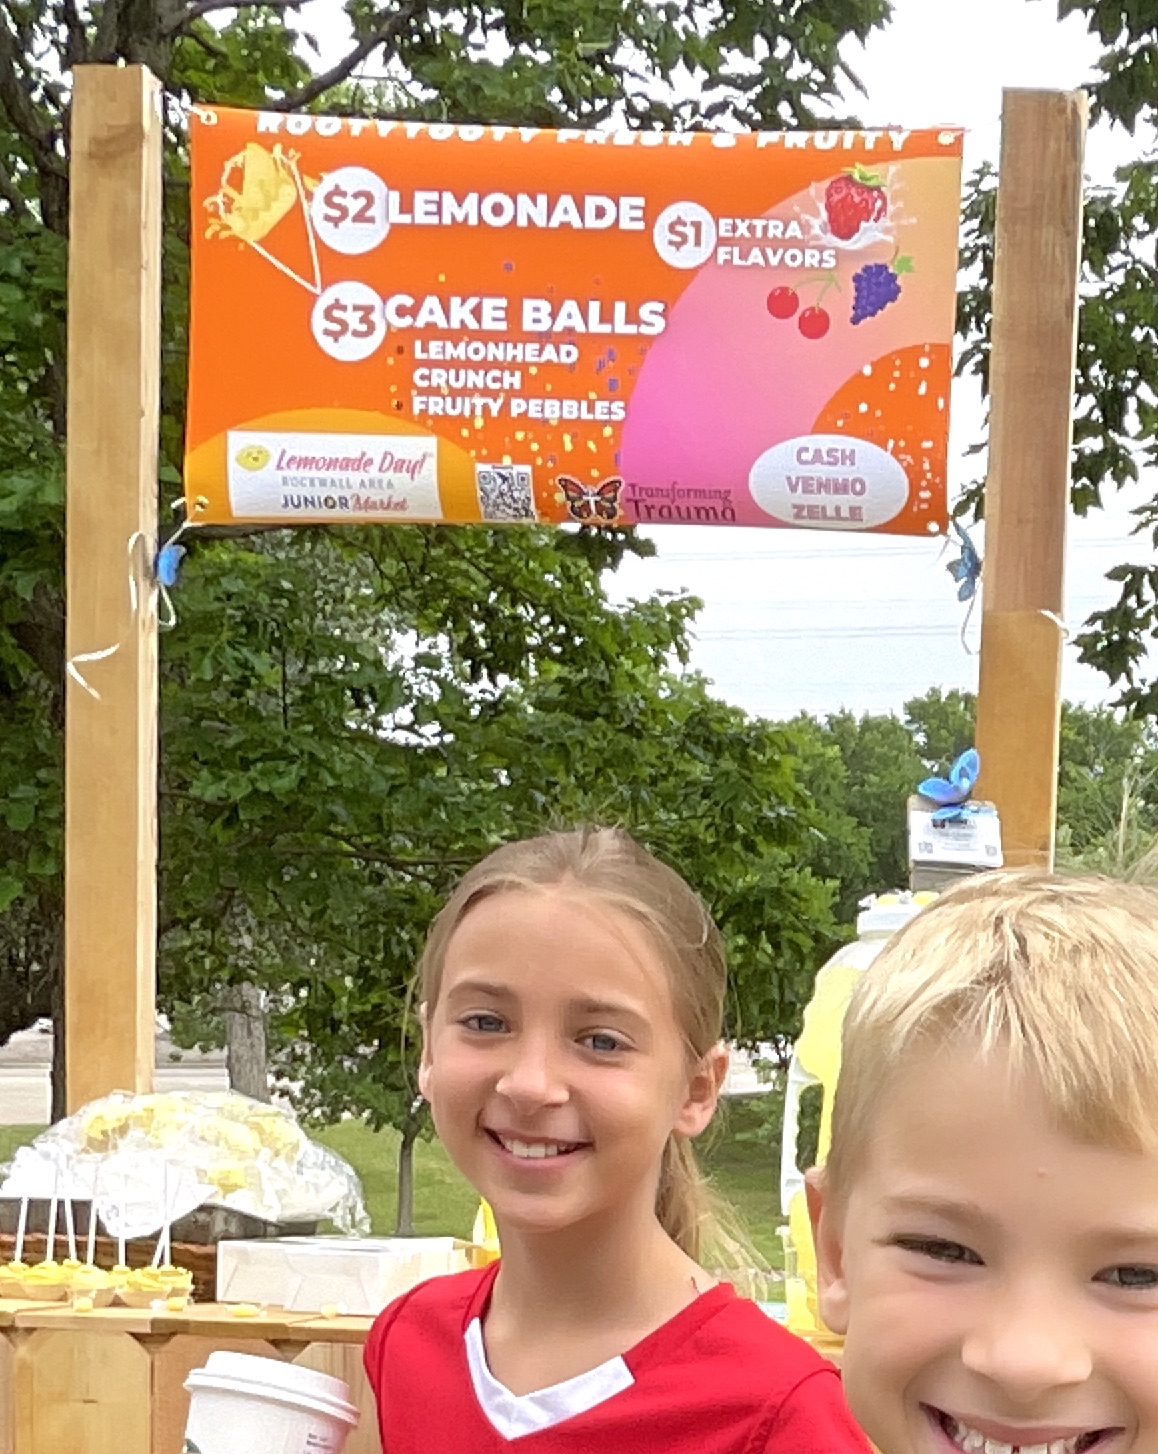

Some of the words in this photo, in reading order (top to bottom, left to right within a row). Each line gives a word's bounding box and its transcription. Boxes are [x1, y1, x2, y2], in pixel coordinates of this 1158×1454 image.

[321, 184, 377, 229] $2
[388, 190, 646, 231] LEMONADE
[667, 214, 702, 253] $1
[717, 218, 804, 241] EXTRA
[716, 246, 837, 269] FLAVORS
[322, 297, 377, 344] $3
[383, 294, 508, 332] CAKE
[521, 298, 667, 337] BALLS
[413, 340, 579, 365] LEMONHEAD
[412, 367, 522, 390] CRUNCH
[412, 396, 504, 419] FRUITY
[509, 397, 627, 422] PEBBLES
[275, 448, 375, 474] Lemonade
[796, 446, 857, 467] CASH
[281, 476, 354, 490] ROCKWALL
[358, 477, 395, 490] AREA
[627, 481, 733, 507] Transforming
[784, 474, 867, 498] VENMO
[624, 498, 737, 523] Trauma
[791, 503, 864, 523] ZELLE
